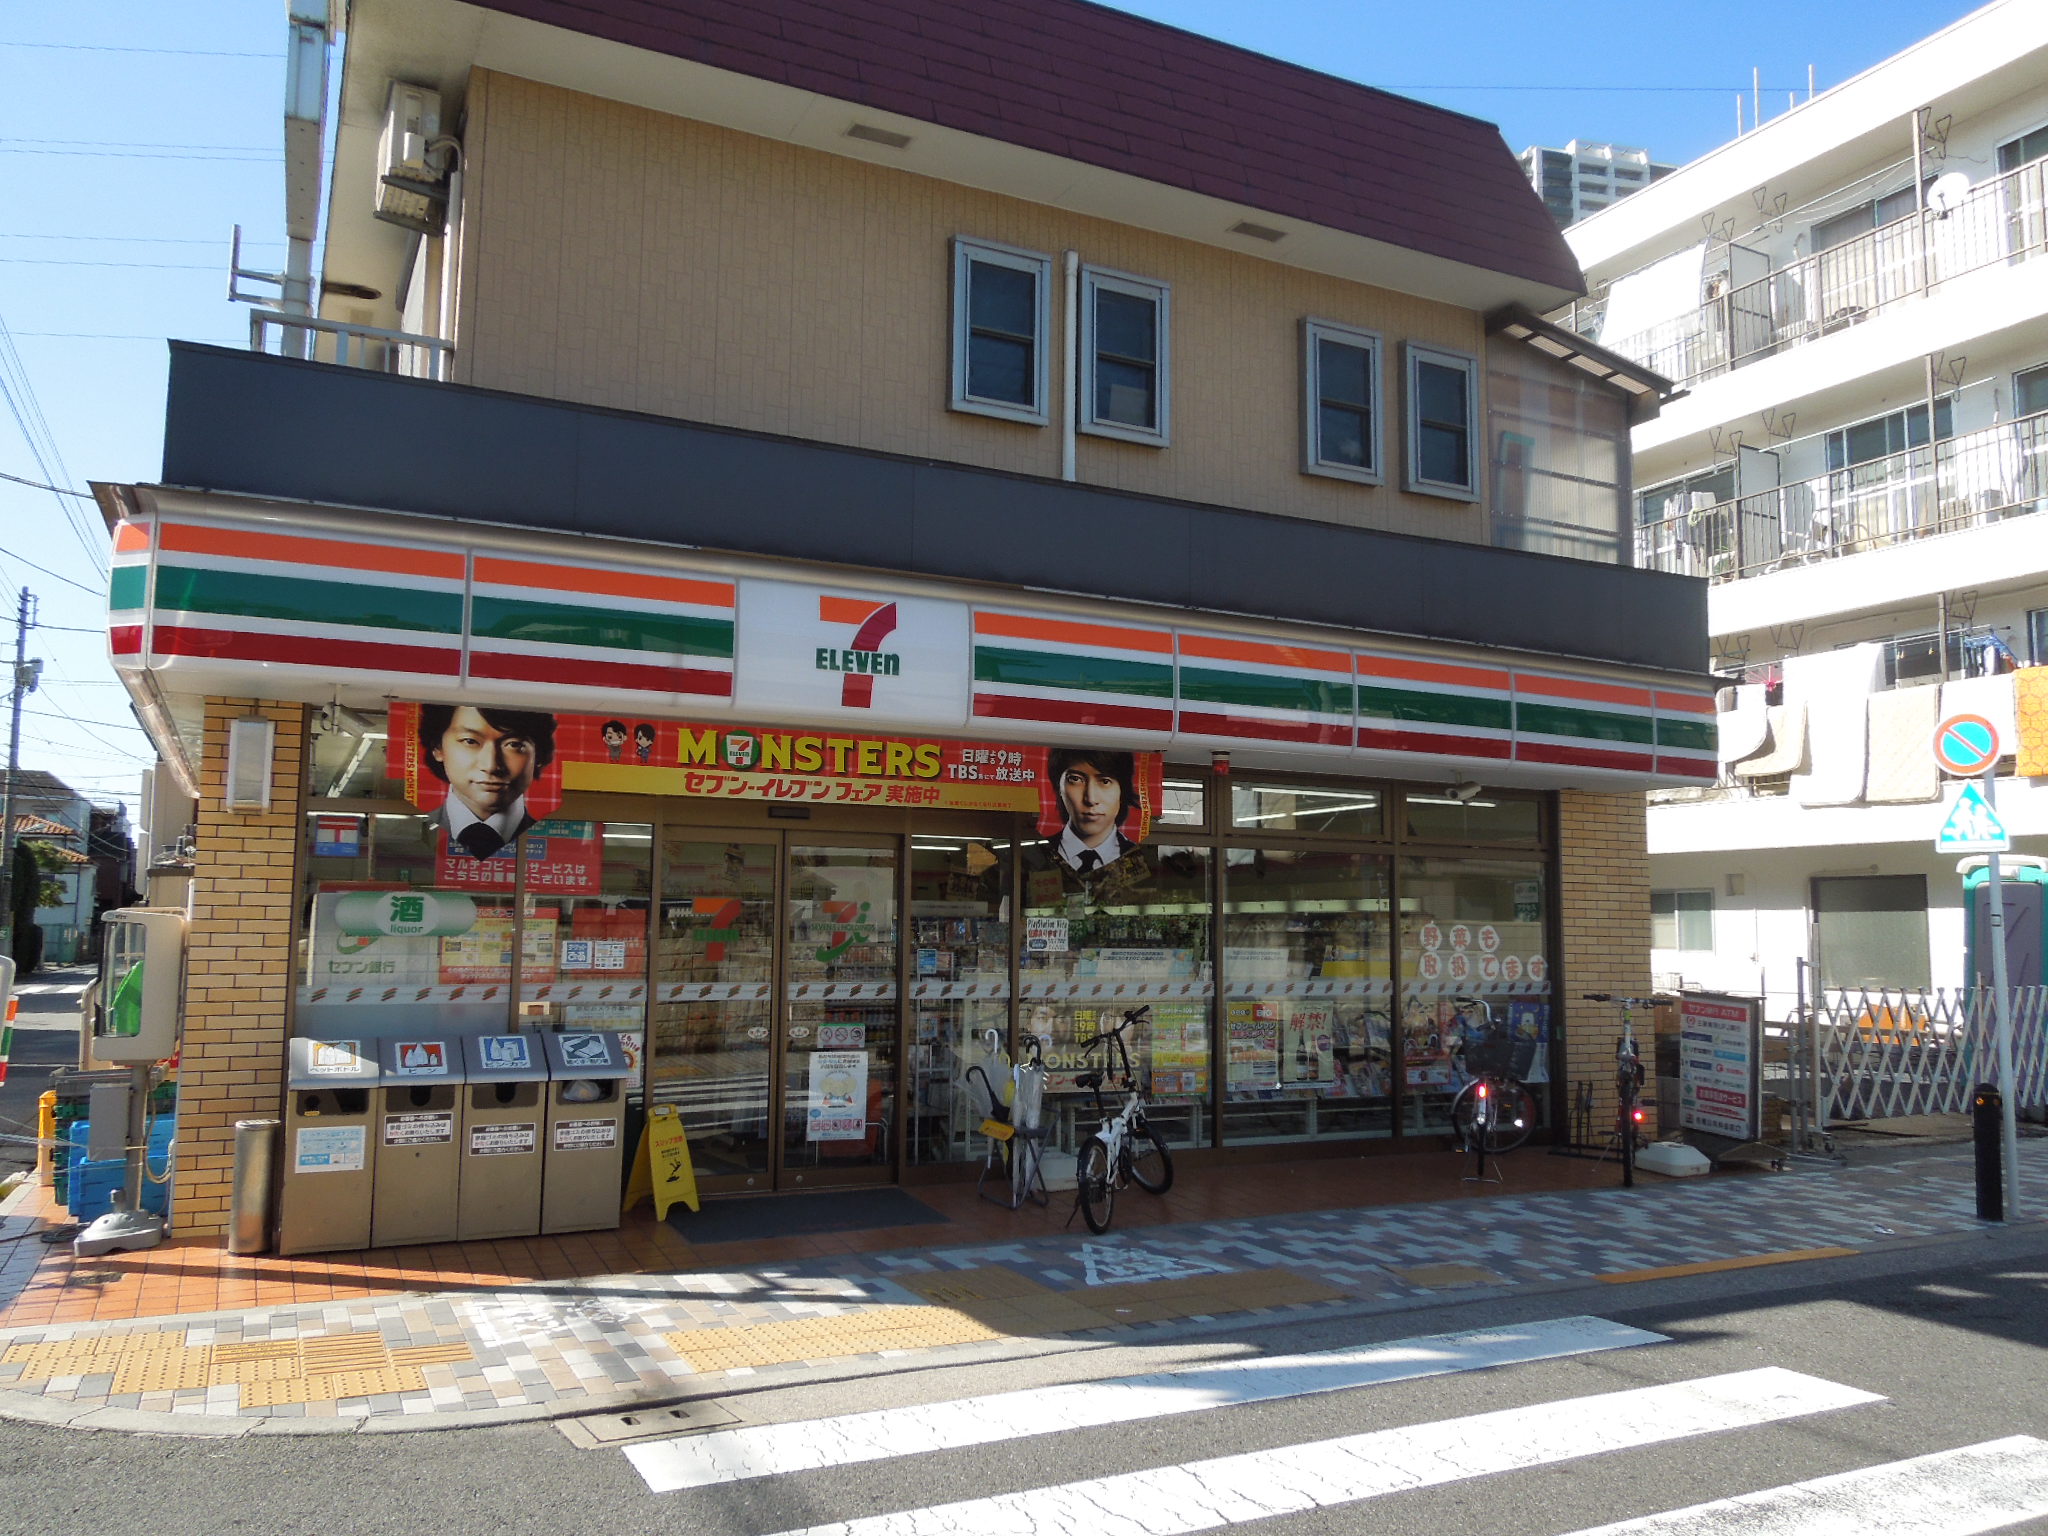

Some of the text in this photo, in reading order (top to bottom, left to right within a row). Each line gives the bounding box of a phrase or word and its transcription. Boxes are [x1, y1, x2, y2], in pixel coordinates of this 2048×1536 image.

[836, 782, 883, 803] フェア
[886, 784, 940, 805] 実施中
[390, 896, 425, 922] 酒
[390, 923, 424, 934] liquor
[328, 960, 396, 974] セブン銀行
